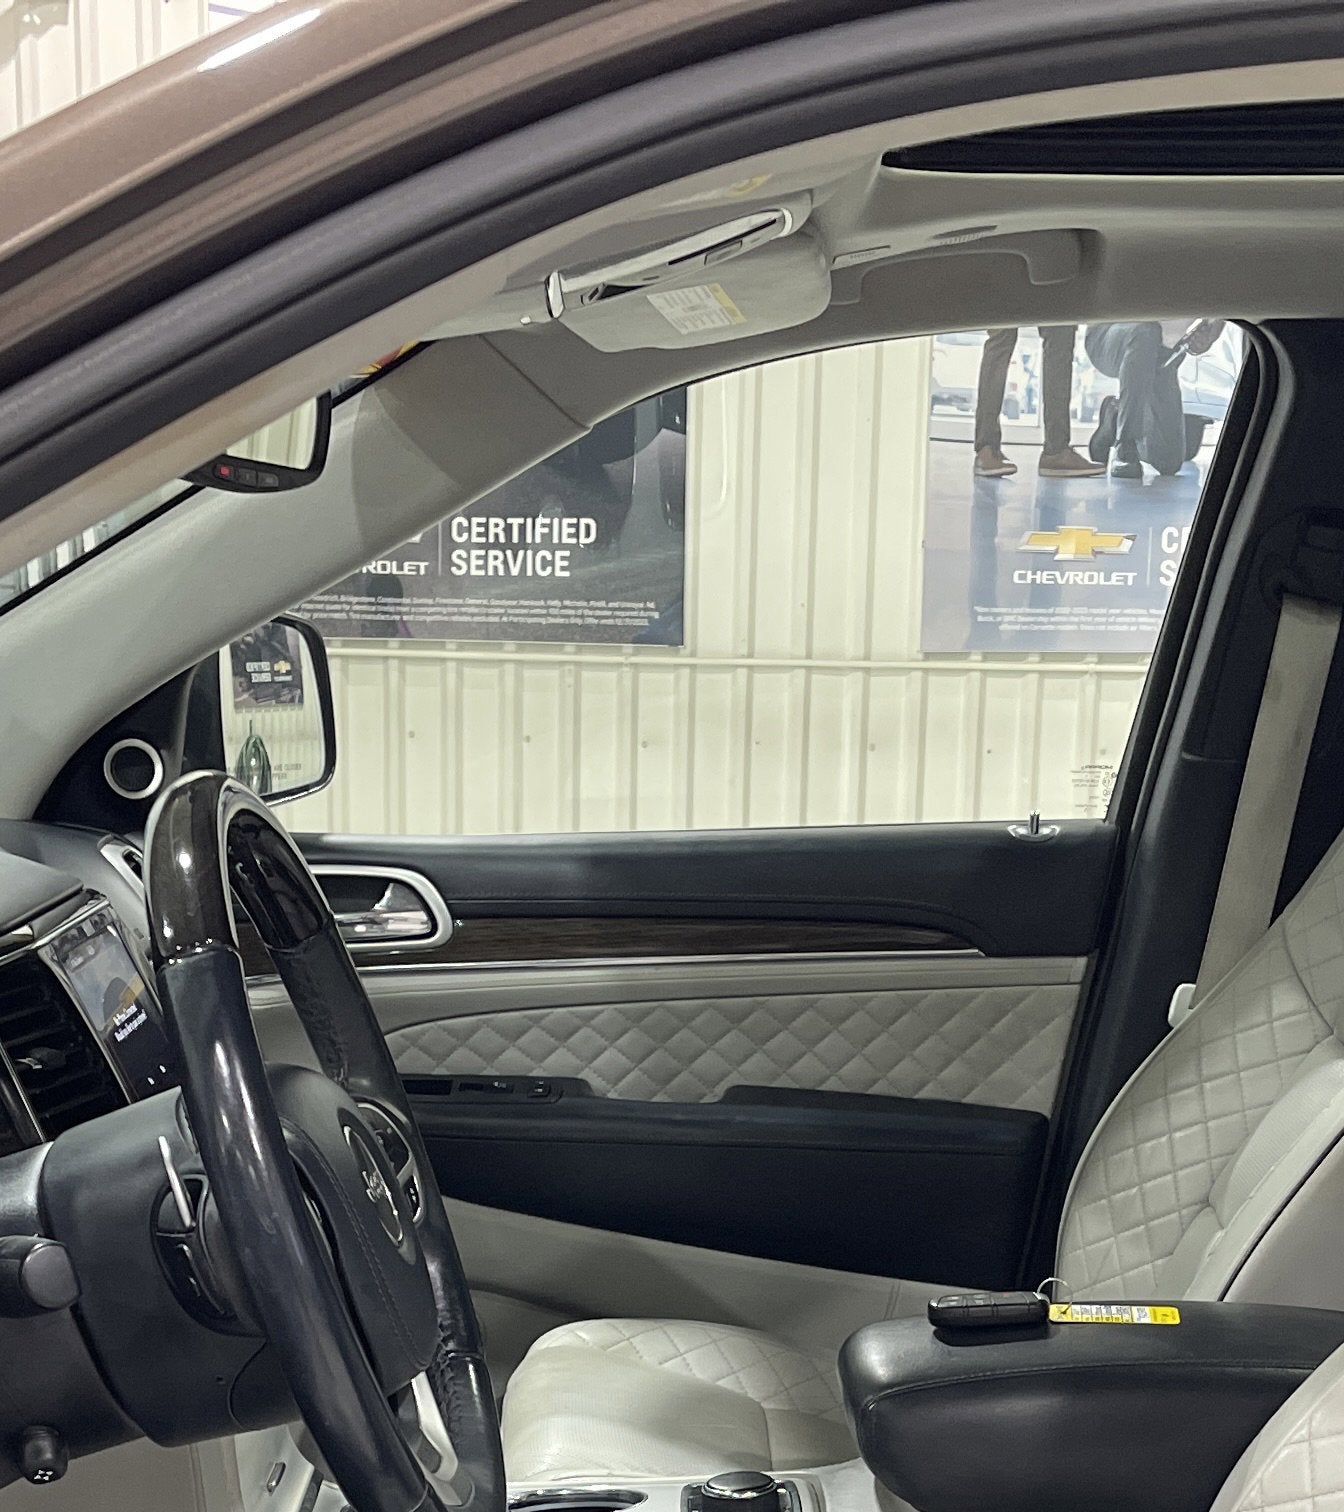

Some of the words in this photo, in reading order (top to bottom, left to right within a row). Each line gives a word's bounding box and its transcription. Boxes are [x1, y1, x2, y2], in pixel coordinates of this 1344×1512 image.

[450, 515, 598, 546] CERTIFIED
[450, 549, 571, 577] SERVICE
[1013, 569, 1138, 587] CHEVROLET
